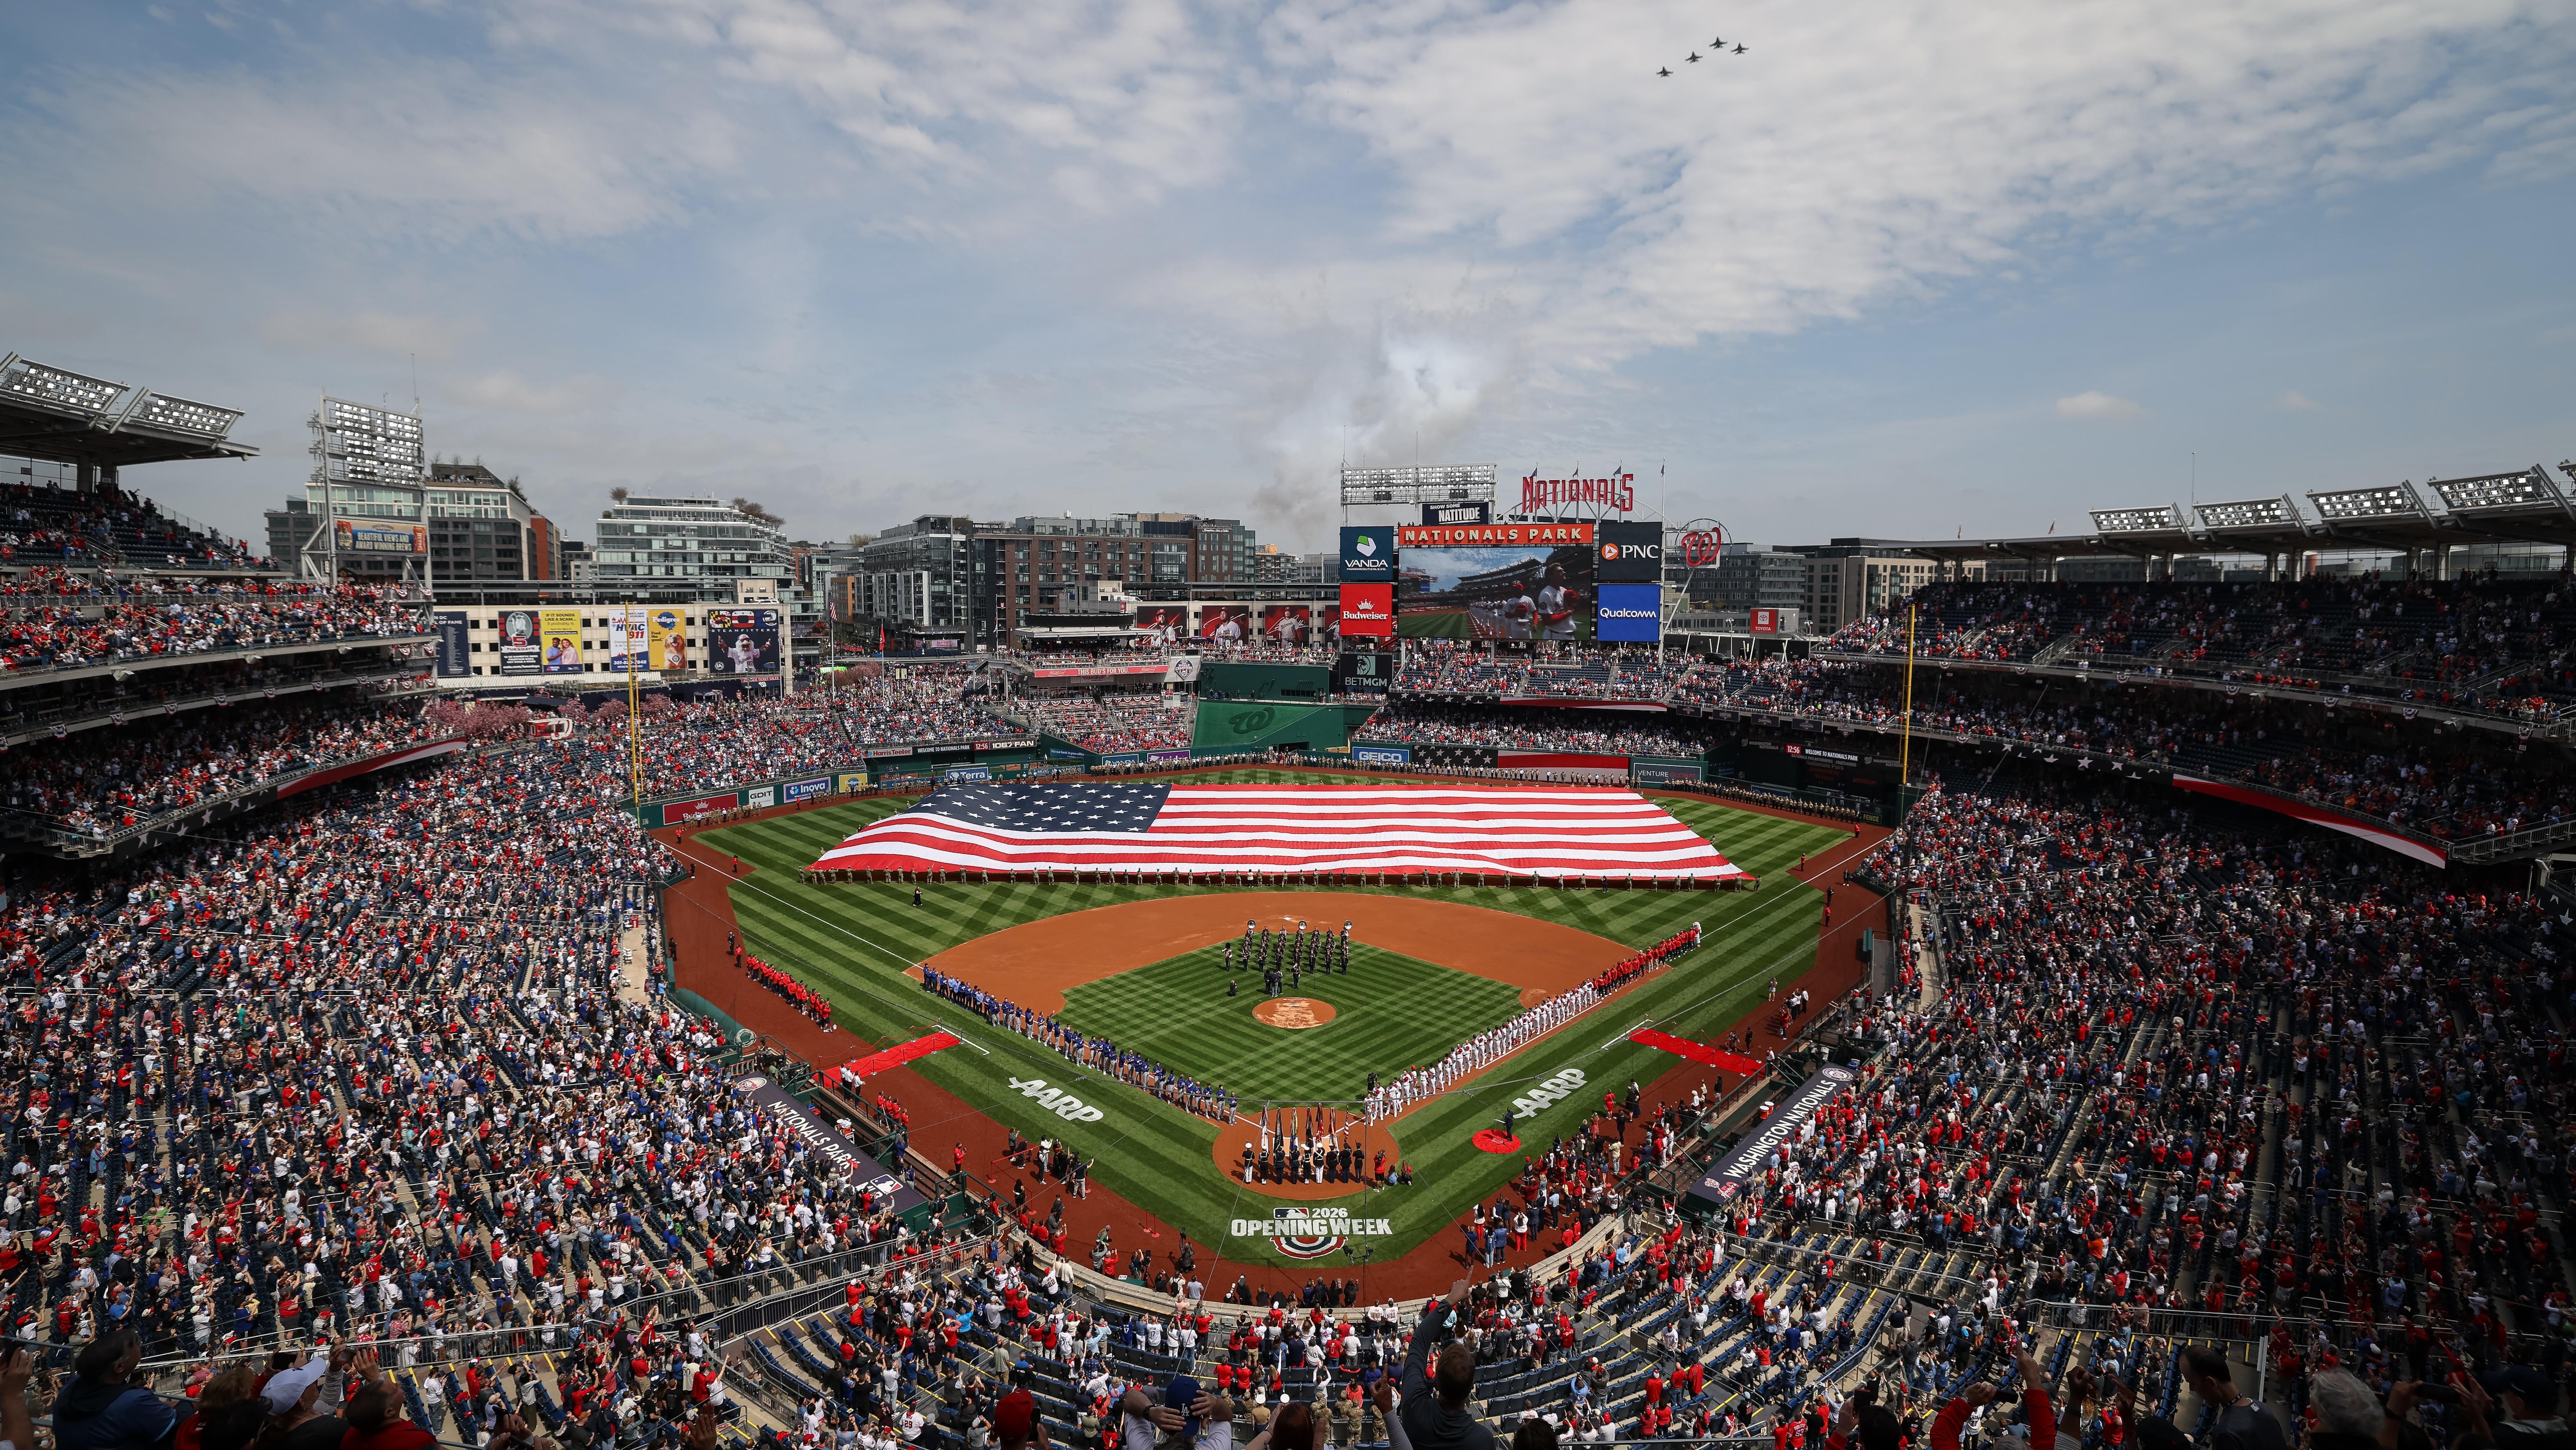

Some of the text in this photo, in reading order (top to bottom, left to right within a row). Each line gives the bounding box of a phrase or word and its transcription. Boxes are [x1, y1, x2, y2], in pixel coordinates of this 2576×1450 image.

[1522, 474, 1634, 513] NATIONALS
[1438, 507, 1480, 522] NATITUDE
[357, 532, 410, 543] BEAUTIFUL VIEWS AND
[1405, 528, 1582, 541] NATIONALS PARK
[355, 541, 412, 551] AWARD WINNING BREWS
[1620, 545, 1659, 559] PNC
[1345, 559, 1388, 568] VANDA
[1343, 611, 1388, 619] Budweiser
[1600, 608, 1657, 618] Qualcomm
[1345, 677, 1387, 686] BETMGM
[1787, 746, 1800, 754] 12:56
[1359, 751, 1402, 763] GEICO
[1827, 752, 1848, 760] NATIONALS
[960, 771, 986, 780] Terra
[1853, 777, 1876, 785] verizon
[801, 782, 825, 793] Inova
[750, 790, 773, 799] GDIT
[1863, 814, 1879, 822] FENCE
[1512, 1068, 1588, 1119] AARP
[1007, 1077, 1104, 1122] AARP
[1723, 1080, 1837, 1178] WASHINGTON NATIONALS
[767, 1100, 861, 1170] NATIONALS PARK
[1312, 1207, 1348, 1218] 2026
[1231, 1218, 1393, 1236] OPENING WEEK
[904, 1420, 912, 1428] 29
